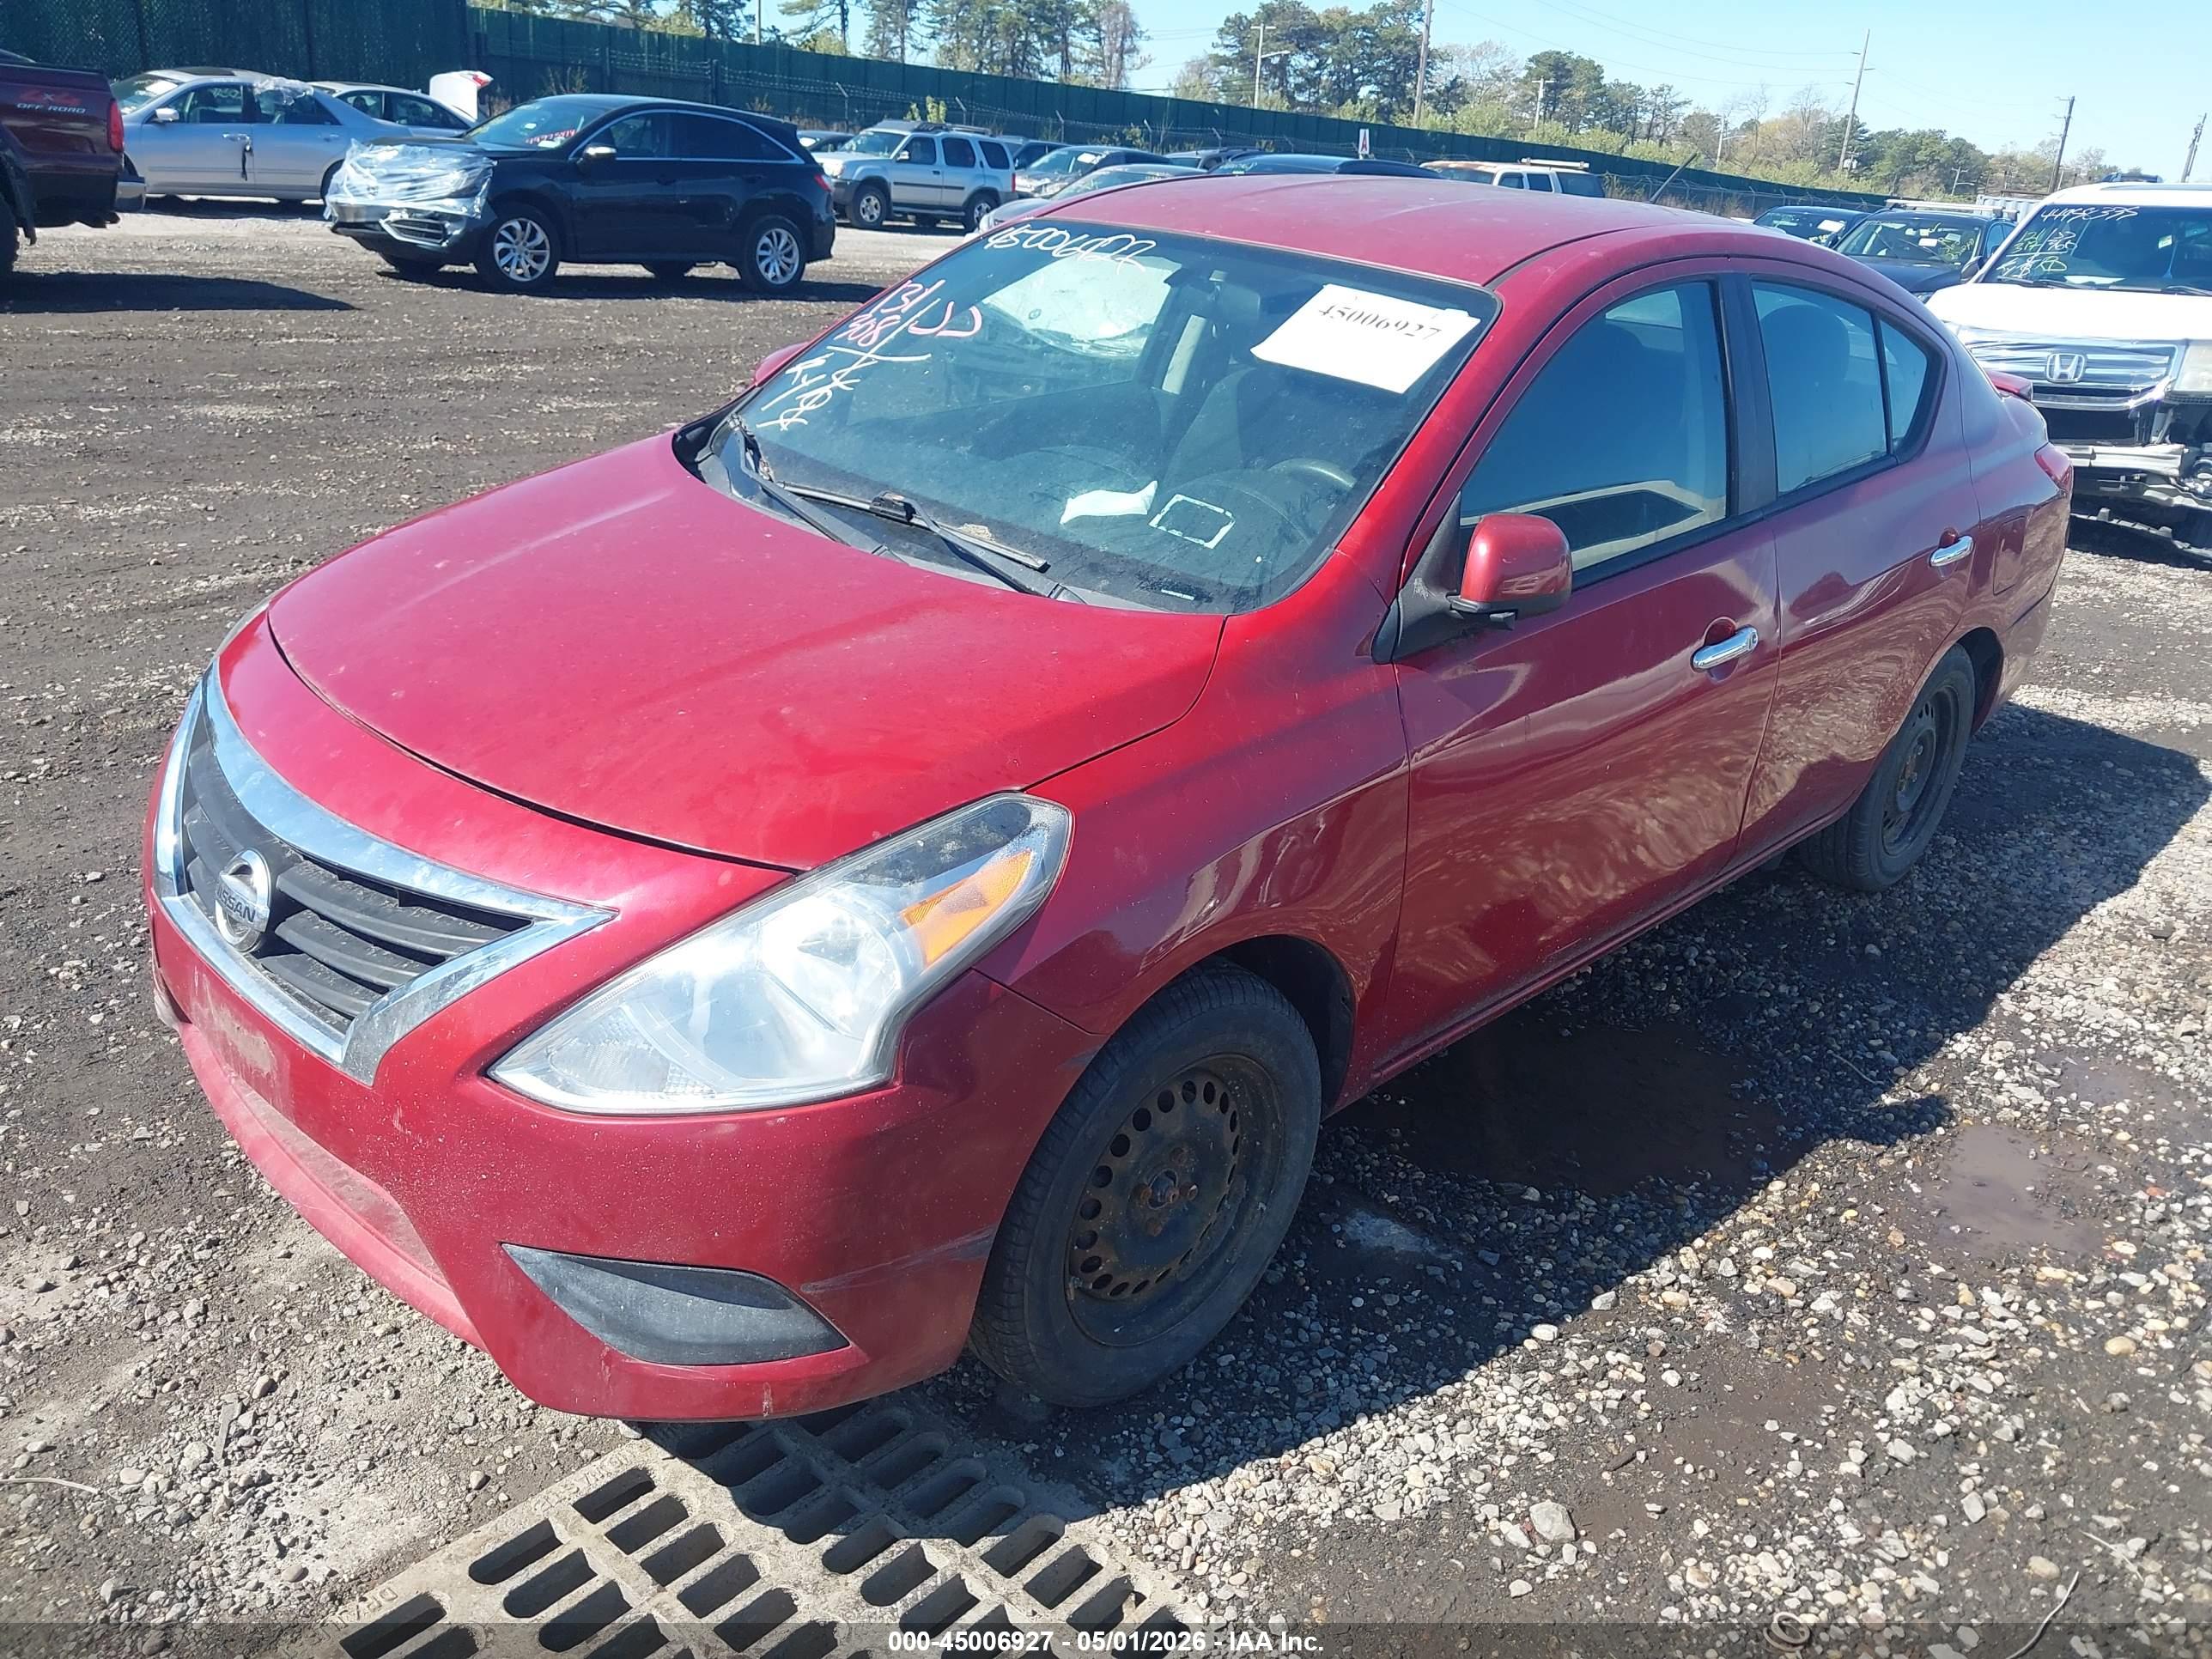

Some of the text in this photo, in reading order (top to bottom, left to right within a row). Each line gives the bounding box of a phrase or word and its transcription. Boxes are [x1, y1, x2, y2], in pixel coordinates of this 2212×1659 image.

[48, 105, 86, 114] ROAD
[1360, 130, 1368, 152] A
[1319, 304, 1443, 341] 45006927
